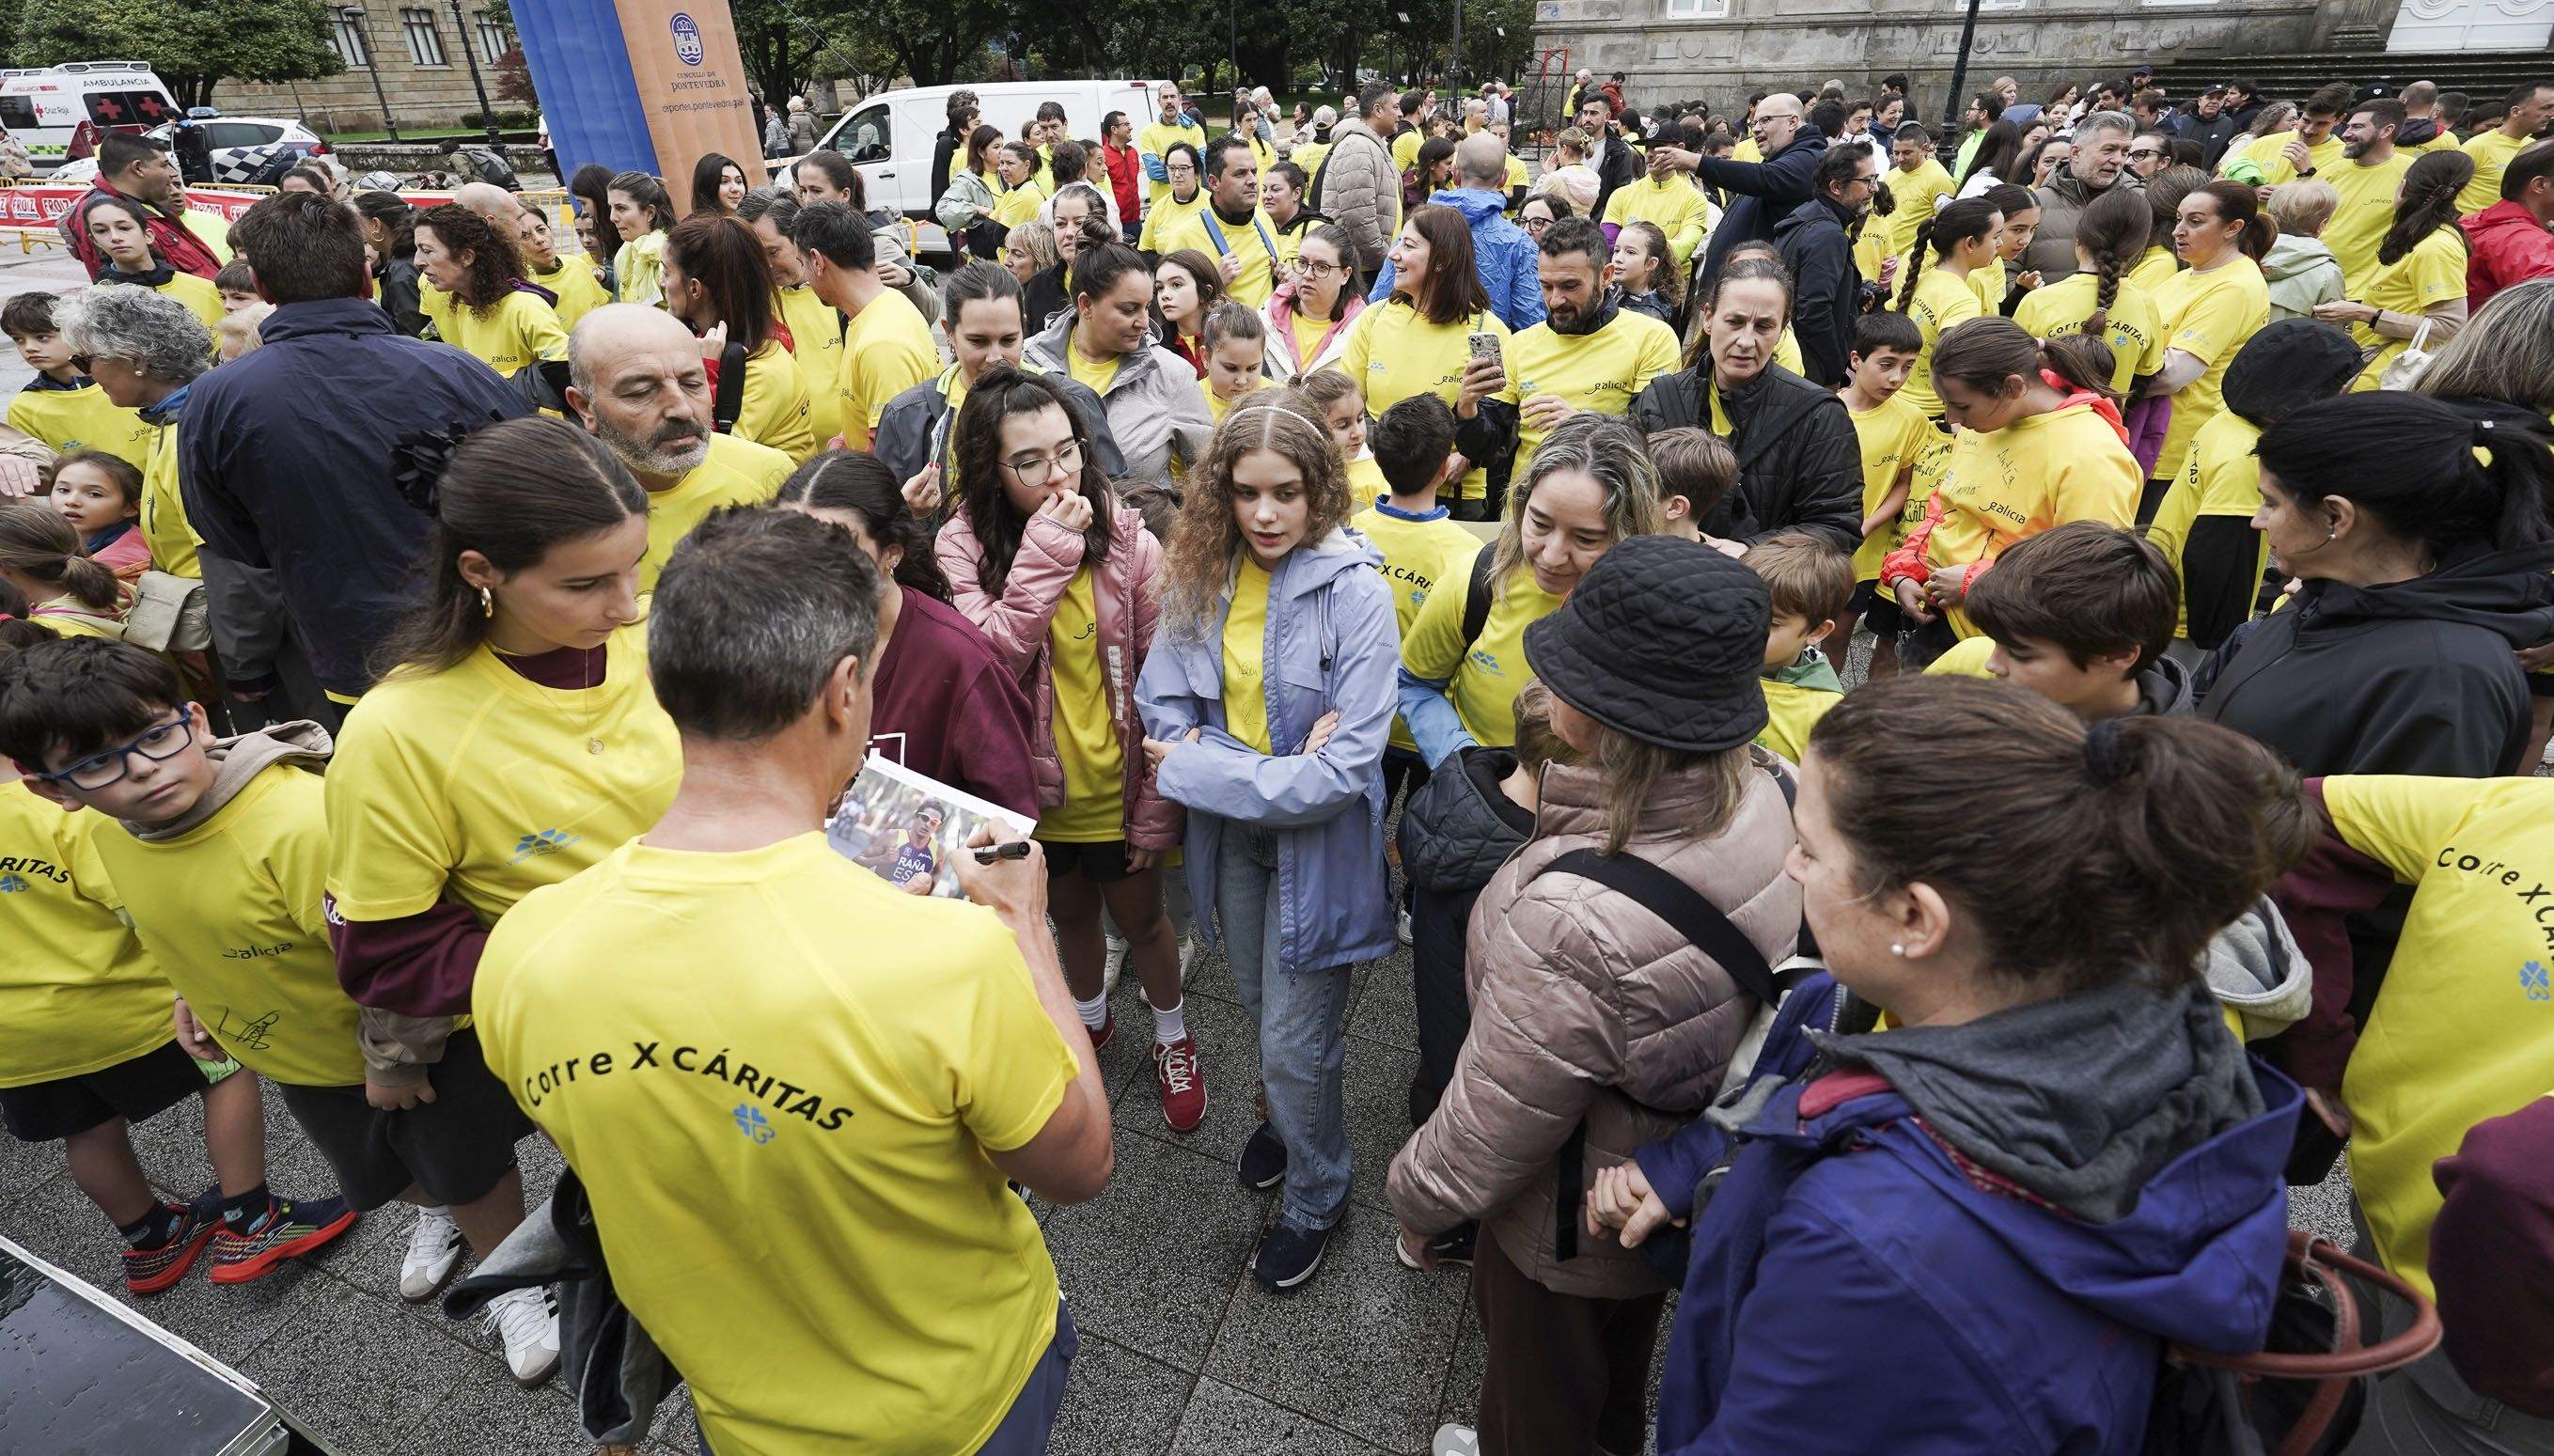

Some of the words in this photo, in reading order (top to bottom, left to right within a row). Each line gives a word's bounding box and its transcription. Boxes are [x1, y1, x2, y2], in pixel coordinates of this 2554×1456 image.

[83, 78, 151, 87] AMBULANCIA
[670, 79, 727, 93] PONTEVEDRA
[662, 98, 744, 113] deportes.pontevedra.gal
[12, 197, 36, 212] FROIZ
[43, 198, 70, 213] FROIZ
[2047, 320, 2086, 338] Corre
[2105, 320, 2146, 347] CÁRITAS
[488, 353, 519, 366] galicia
[1432, 374, 1463, 386] galic
[1584, 381, 1628, 395] galicia
[1872, 453, 1901, 468] galic
[1978, 501, 2026, 524] galicia
[1381, 564, 1391, 575] X
[1394, 567, 1434, 593] CÁRI
[0, 856, 71, 884] RITAS
[898, 855, 926, 873] RAÑA
[893, 866, 916, 883] ES
[2436, 847, 2520, 885] Corre
[2515, 882, 2552, 905] X
[525, 1051, 613, 1107] Corre
[630, 1041, 660, 1071] X
[671, 1045, 854, 1132] CÁRITAS
